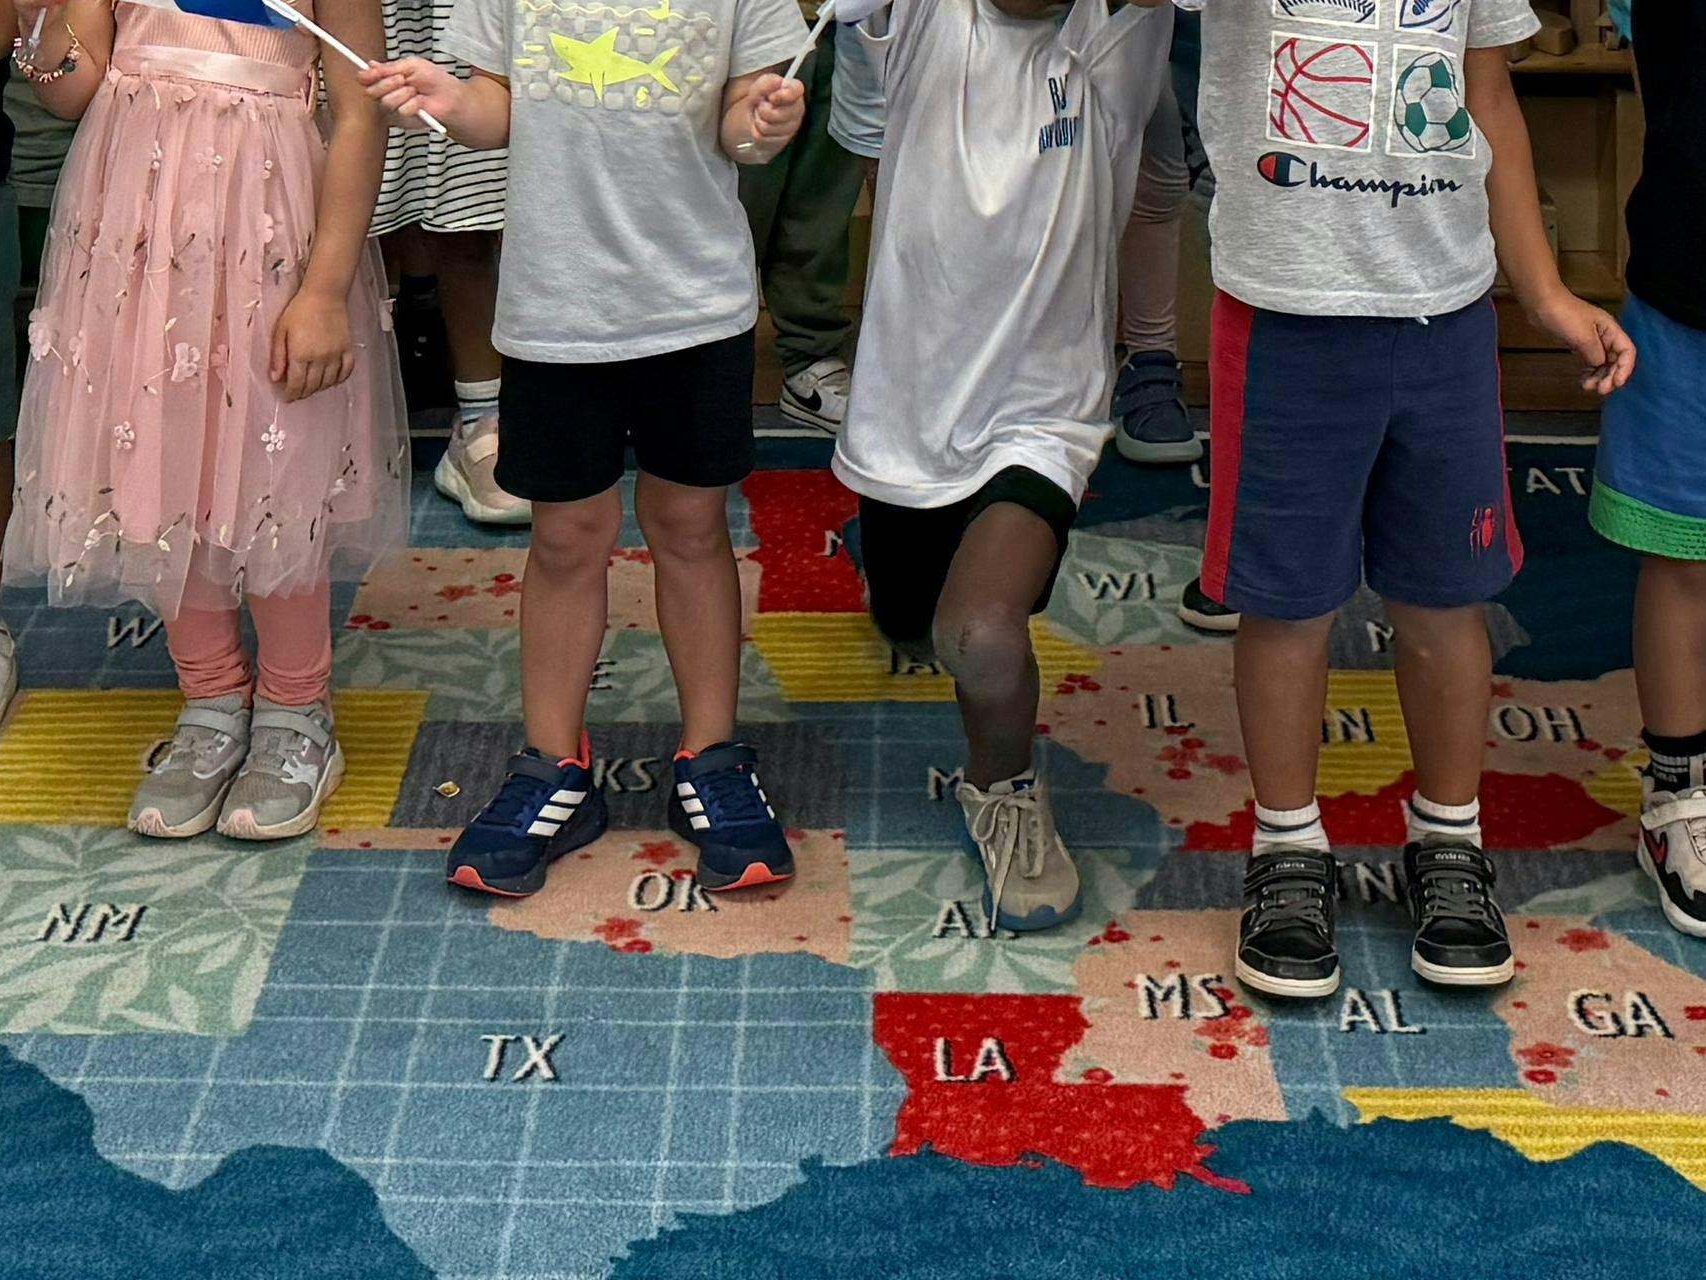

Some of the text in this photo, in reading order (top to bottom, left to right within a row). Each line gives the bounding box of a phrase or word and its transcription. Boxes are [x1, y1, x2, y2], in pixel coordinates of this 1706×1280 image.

[1256, 150, 1463, 209] Champion
[1077, 572, 1157, 601] WI
[1139, 693, 1196, 729] IL
[1494, 704, 1586, 742] OH
[592, 756, 661, 793] KS
[32, 902, 149, 943] NM
[1135, 973, 1232, 1021] MS
[1339, 987, 1427, 1036] AL
[1566, 989, 1676, 1040] GA
[479, 1032, 567, 1083] TX
[933, 1036, 1019, 1084] LA
